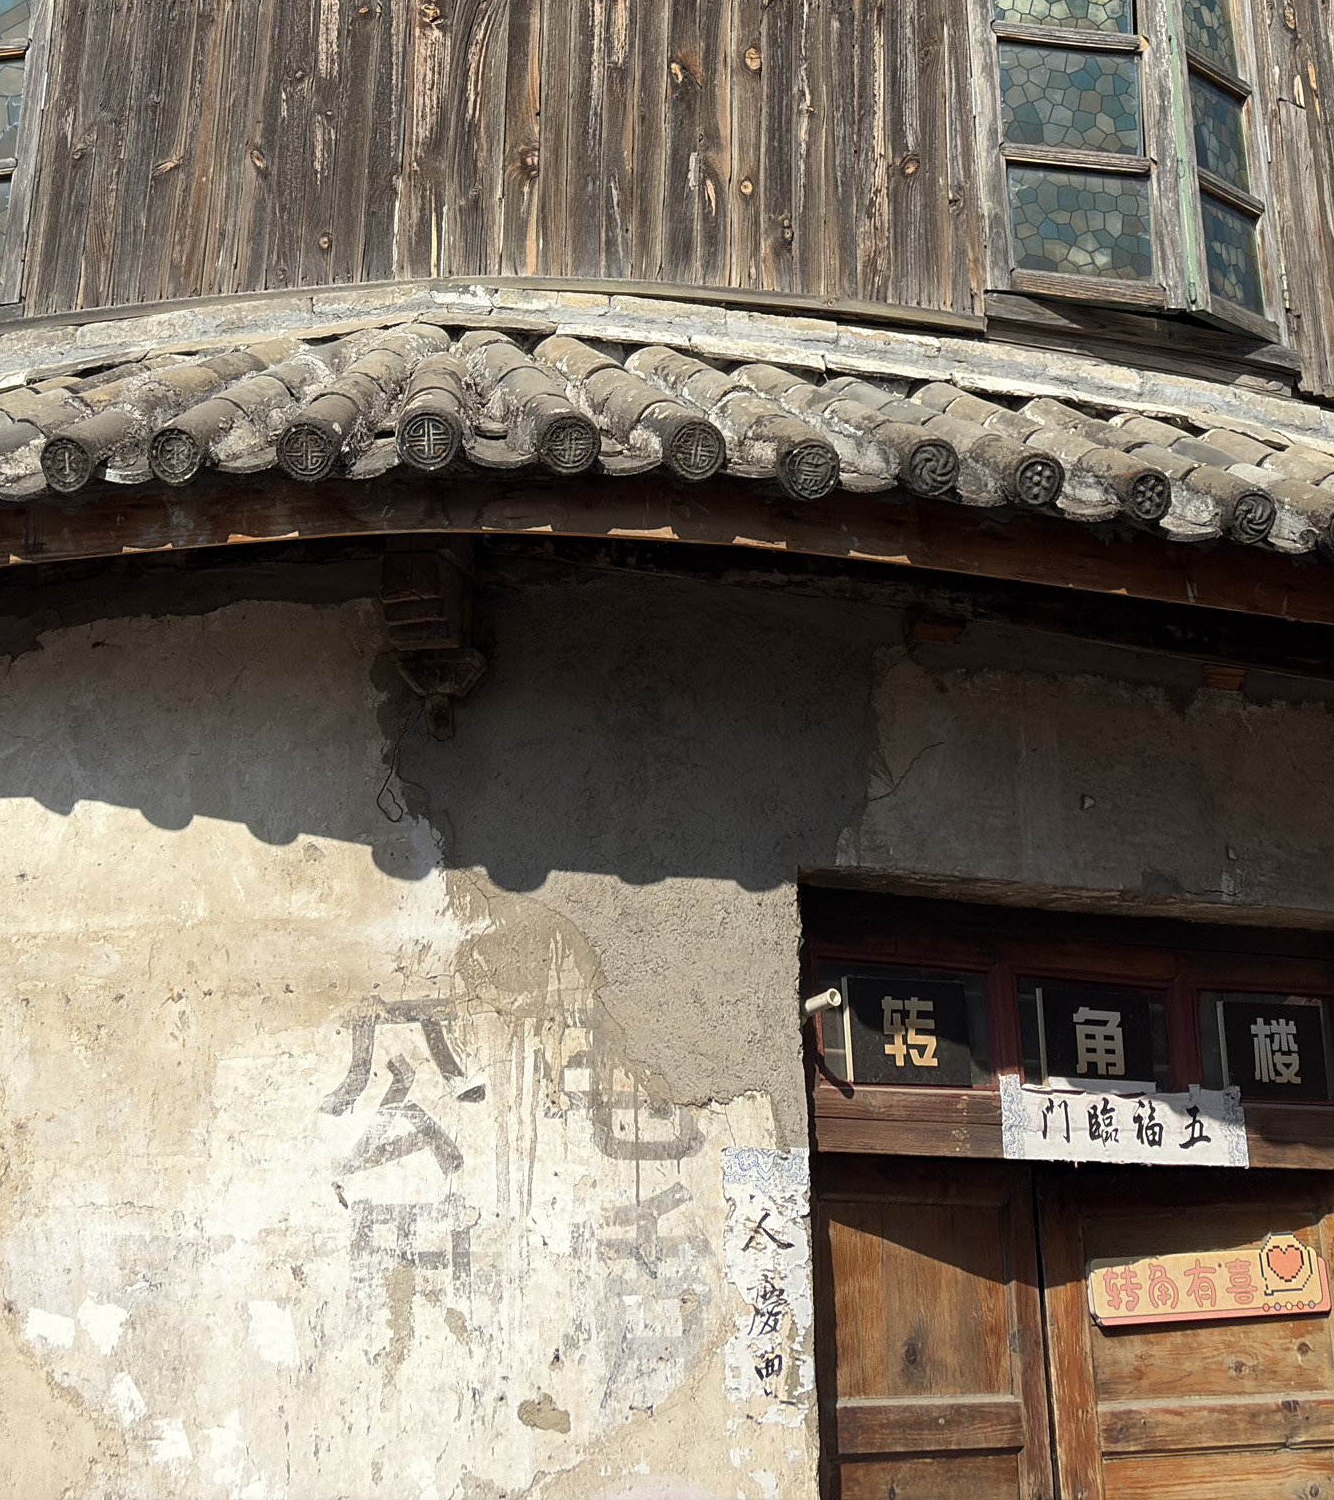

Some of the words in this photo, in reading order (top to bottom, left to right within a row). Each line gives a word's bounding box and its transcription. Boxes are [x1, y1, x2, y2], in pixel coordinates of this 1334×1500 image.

[881, 996, 1303, 1085] 转角楼
[1103, 1258, 1258, 1312] 转角有喜
